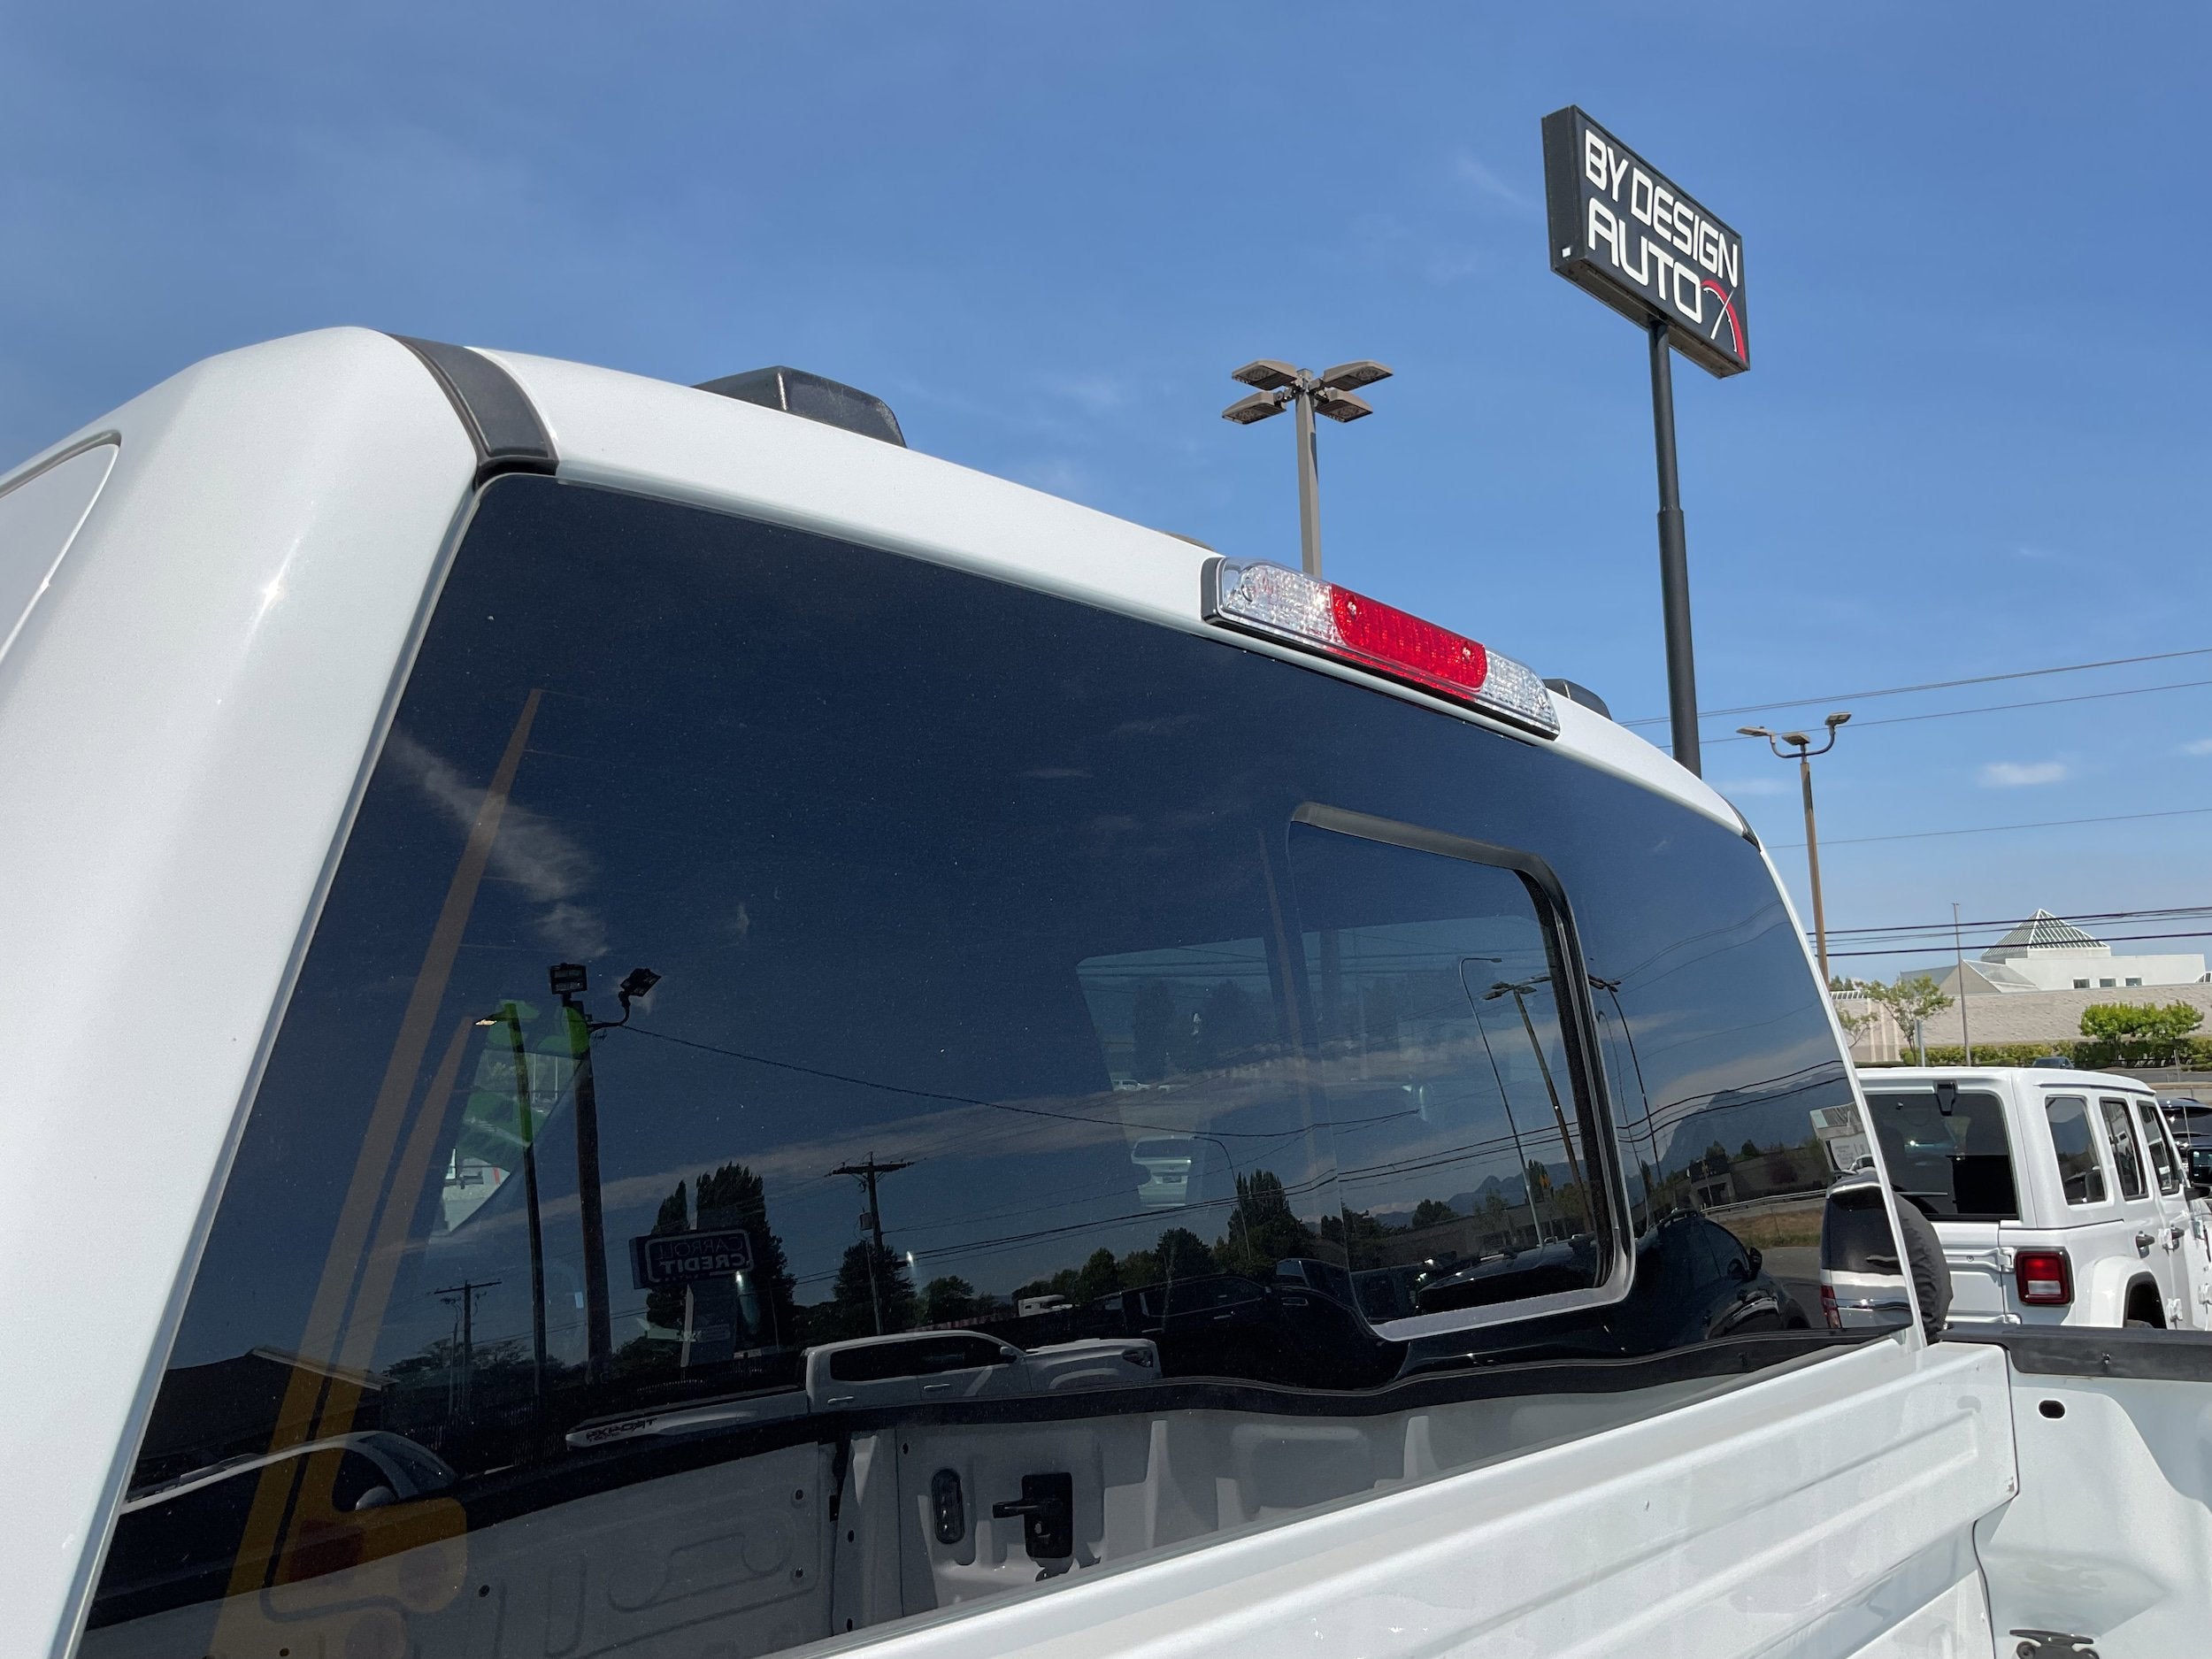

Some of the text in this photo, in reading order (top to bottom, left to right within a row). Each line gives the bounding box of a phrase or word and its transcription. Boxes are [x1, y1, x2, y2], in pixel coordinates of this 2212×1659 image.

[1585, 128, 1739, 288] BY DESIGN
[1587, 196, 1702, 324] AUTO
